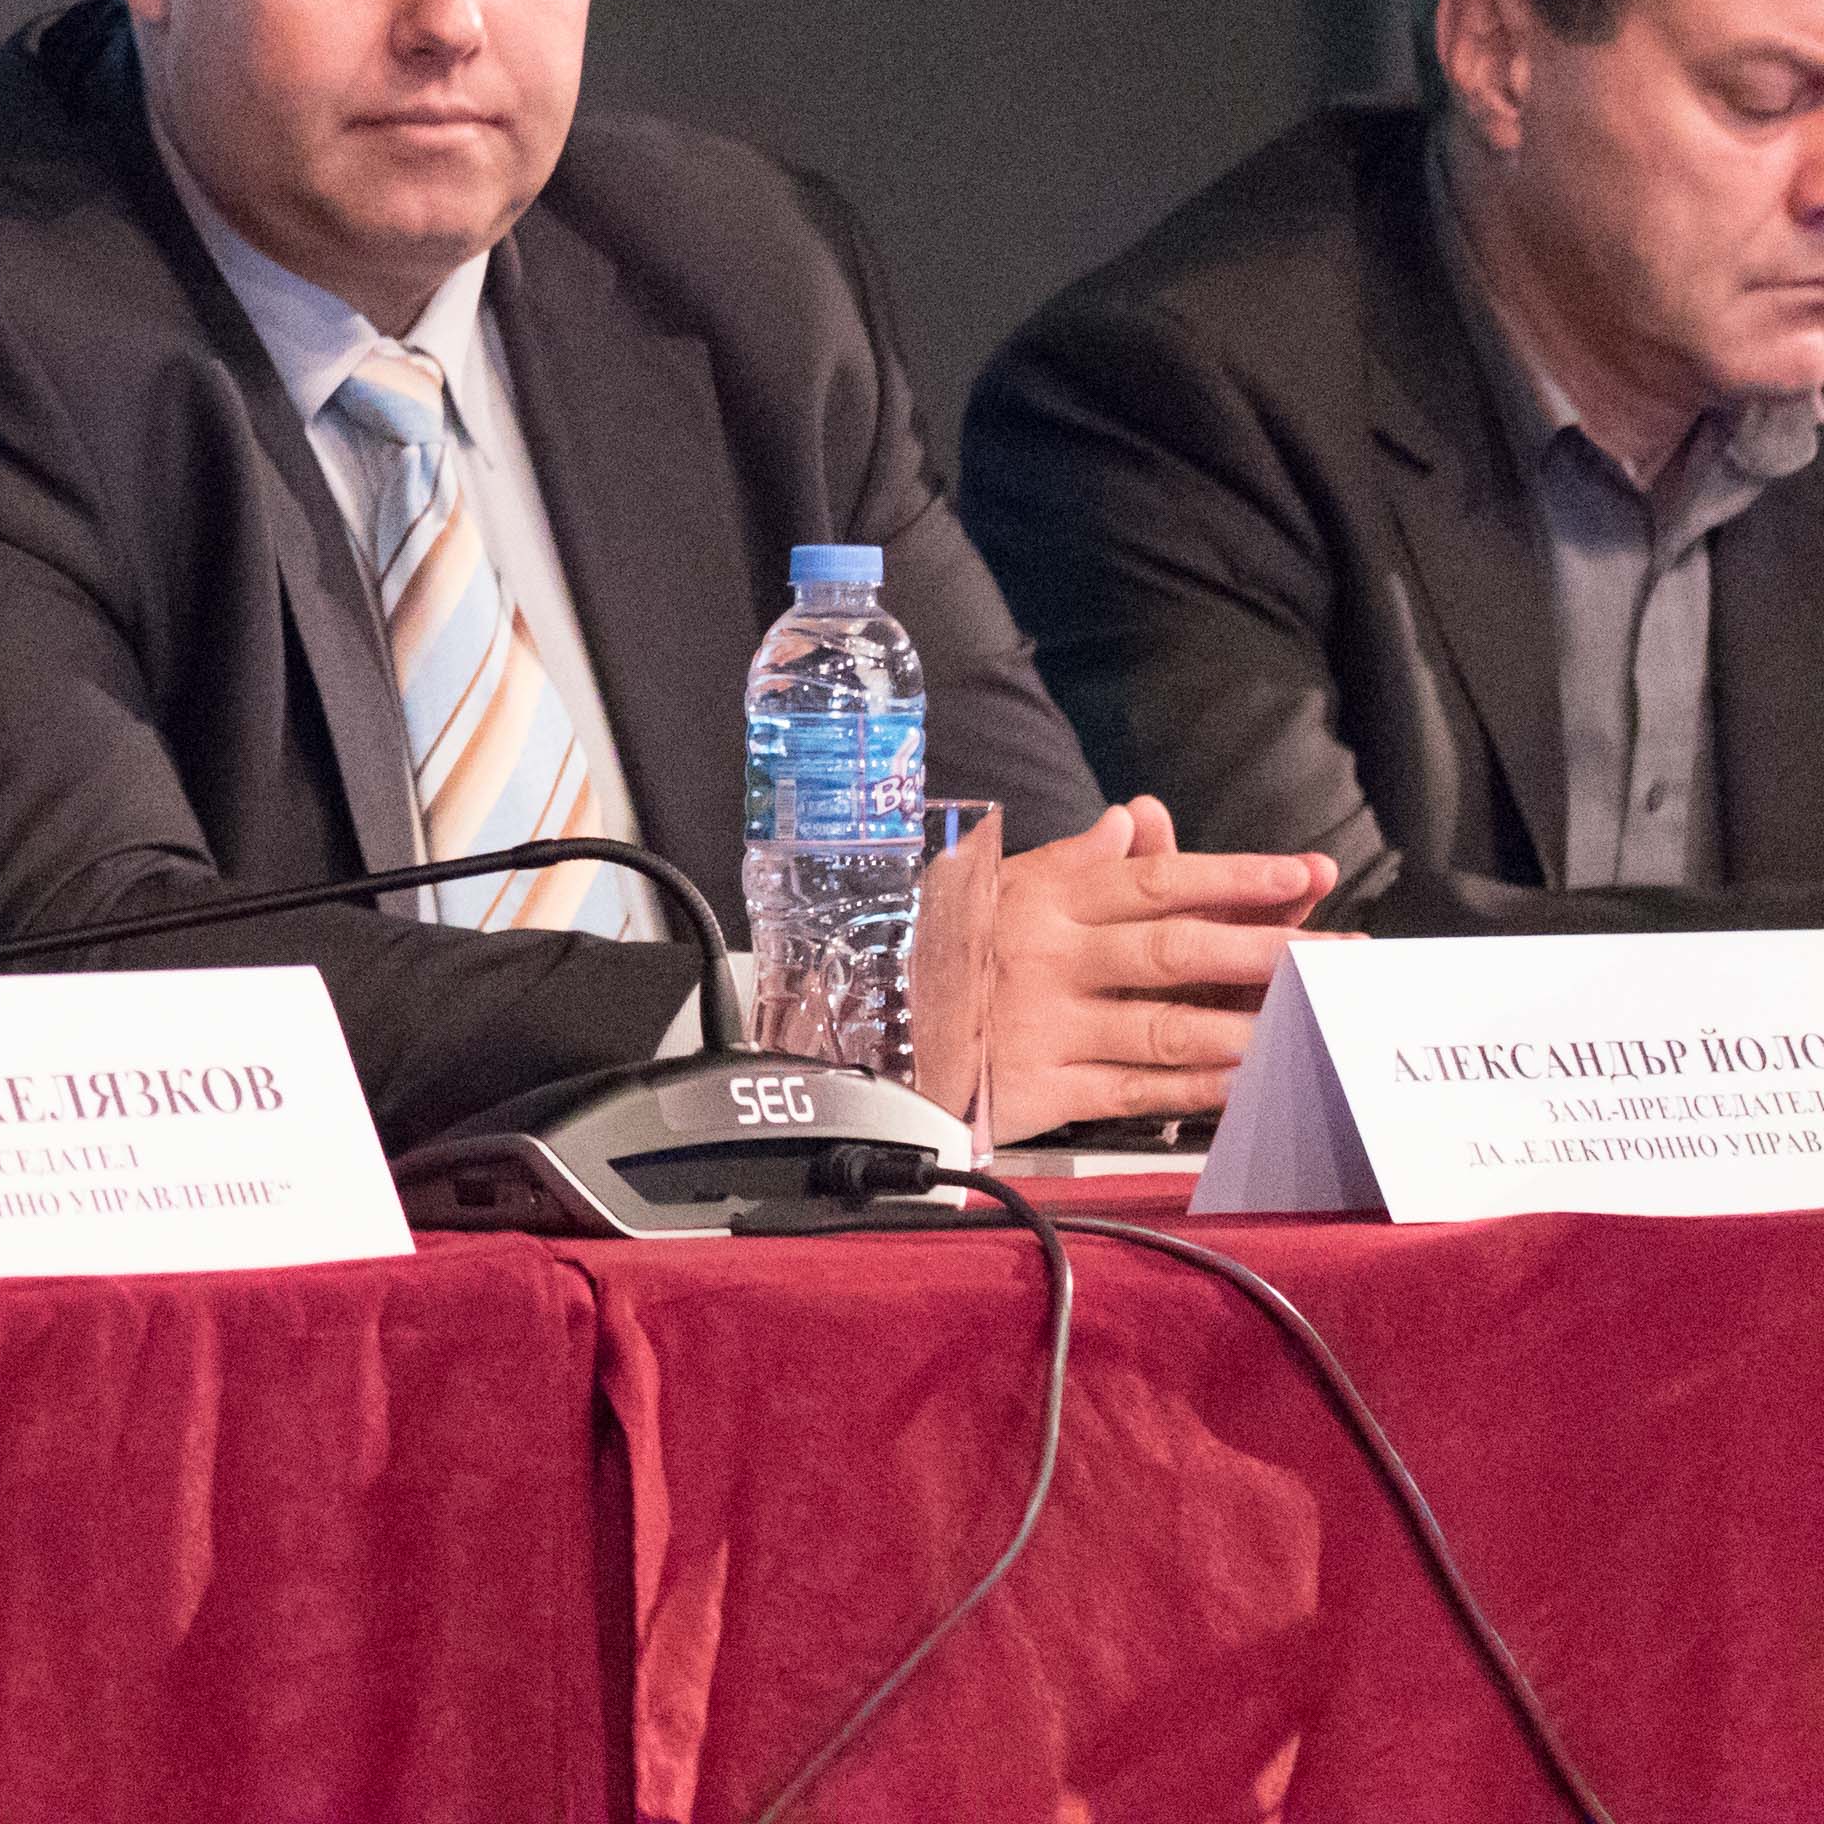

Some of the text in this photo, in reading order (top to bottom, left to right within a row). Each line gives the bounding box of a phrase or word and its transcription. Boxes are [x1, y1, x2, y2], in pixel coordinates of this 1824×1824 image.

[1393, 1037, 1688, 1084] АЛЕКСАНДЪР
[730, 1077, 815, 1124] SEG
[1468, 1140, 1505, 1169] ДА
